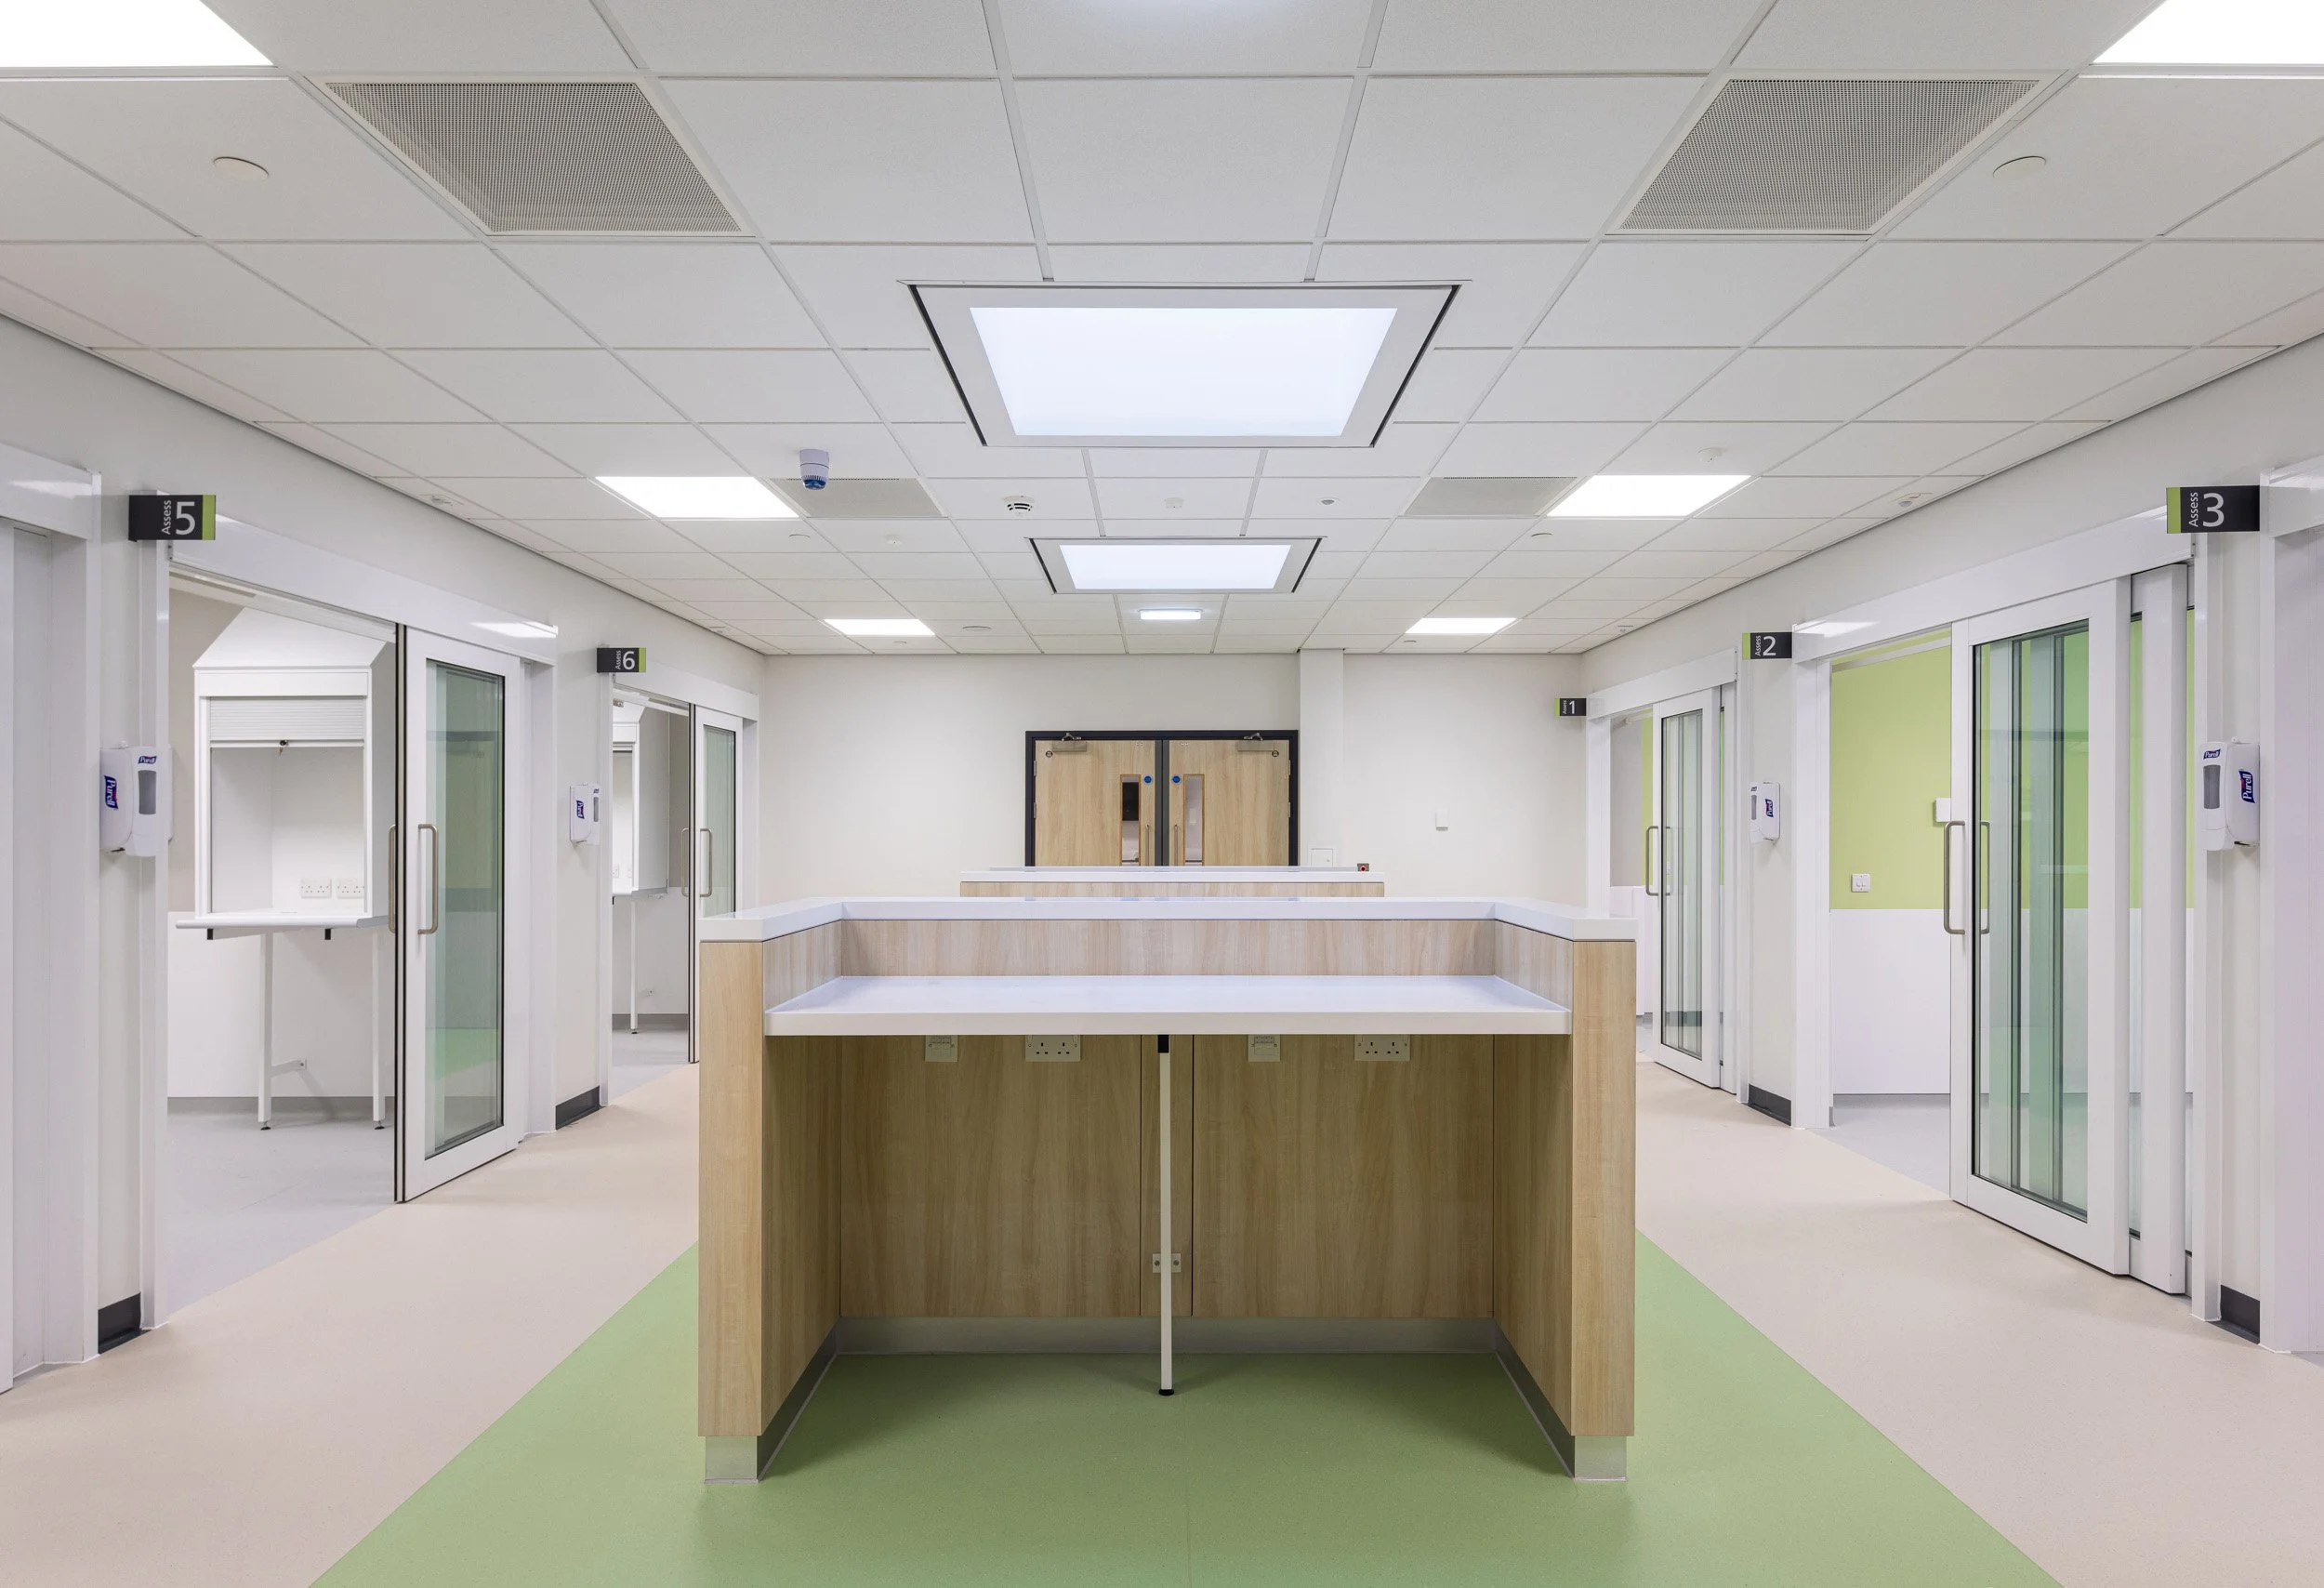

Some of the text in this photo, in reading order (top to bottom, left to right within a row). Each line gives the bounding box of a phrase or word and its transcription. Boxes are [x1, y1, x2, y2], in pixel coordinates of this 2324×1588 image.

[162, 499, 196, 536] Assess 5
[2189, 492, 2225, 527] Assess 3
[1763, 636, 1776, 656] 2
[623, 651, 636, 670] 6
[1568, 700, 1576, 715] 1
[106, 779, 116, 806] Purell
[2242, 774, 2252, 801] Purell
